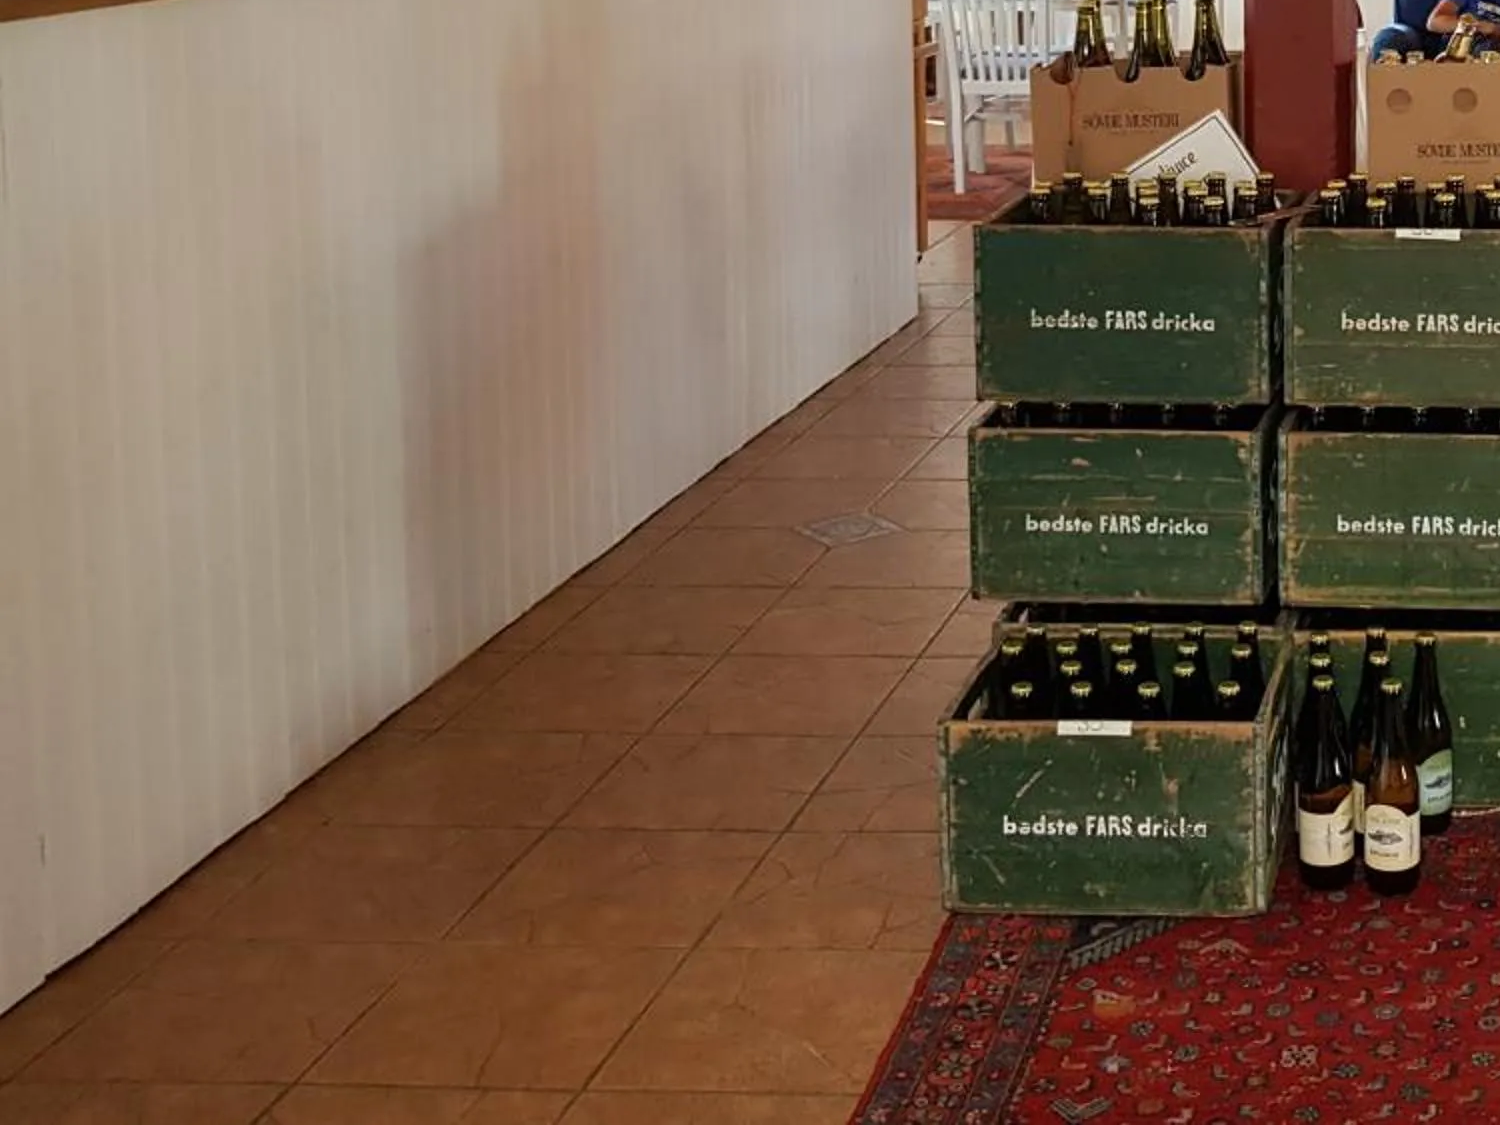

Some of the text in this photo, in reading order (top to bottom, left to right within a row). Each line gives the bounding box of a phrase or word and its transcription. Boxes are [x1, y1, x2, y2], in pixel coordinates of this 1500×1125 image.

[1031, 308, 1215, 332] bedste FARS dricka
[1341, 310, 1410, 332] bedste
[1417, 313, 1460, 333] FARS
[1025, 513, 1209, 535] bedste FARS dricka
[1337, 514, 1405, 534] bedste
[1412, 515, 1455, 535] FARS
[1085, 815, 1133, 837] FARS
